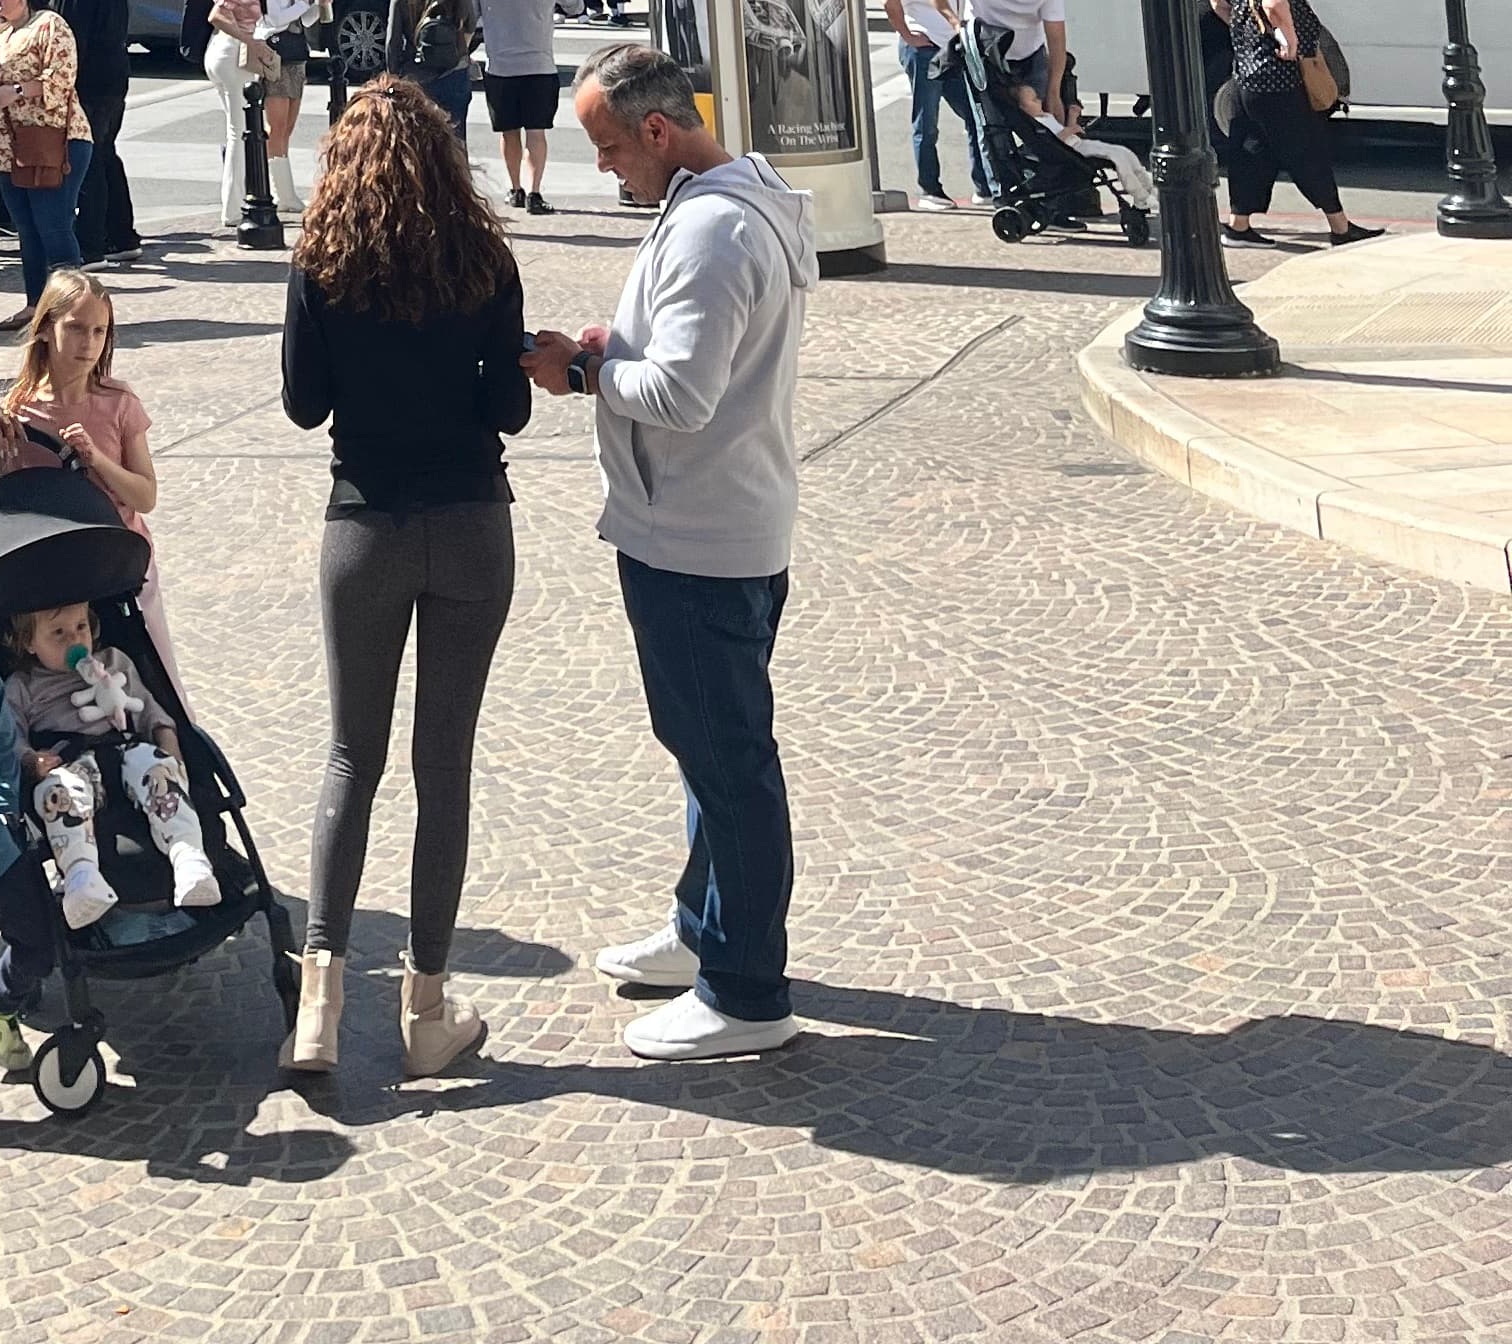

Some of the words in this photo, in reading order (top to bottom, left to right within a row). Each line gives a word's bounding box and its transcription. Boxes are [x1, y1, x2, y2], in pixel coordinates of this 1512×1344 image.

[768, 123, 776, 135] A
[778, 122, 813, 135] Racing
[780, 135, 797, 146] On
[799, 134, 816, 145] The
